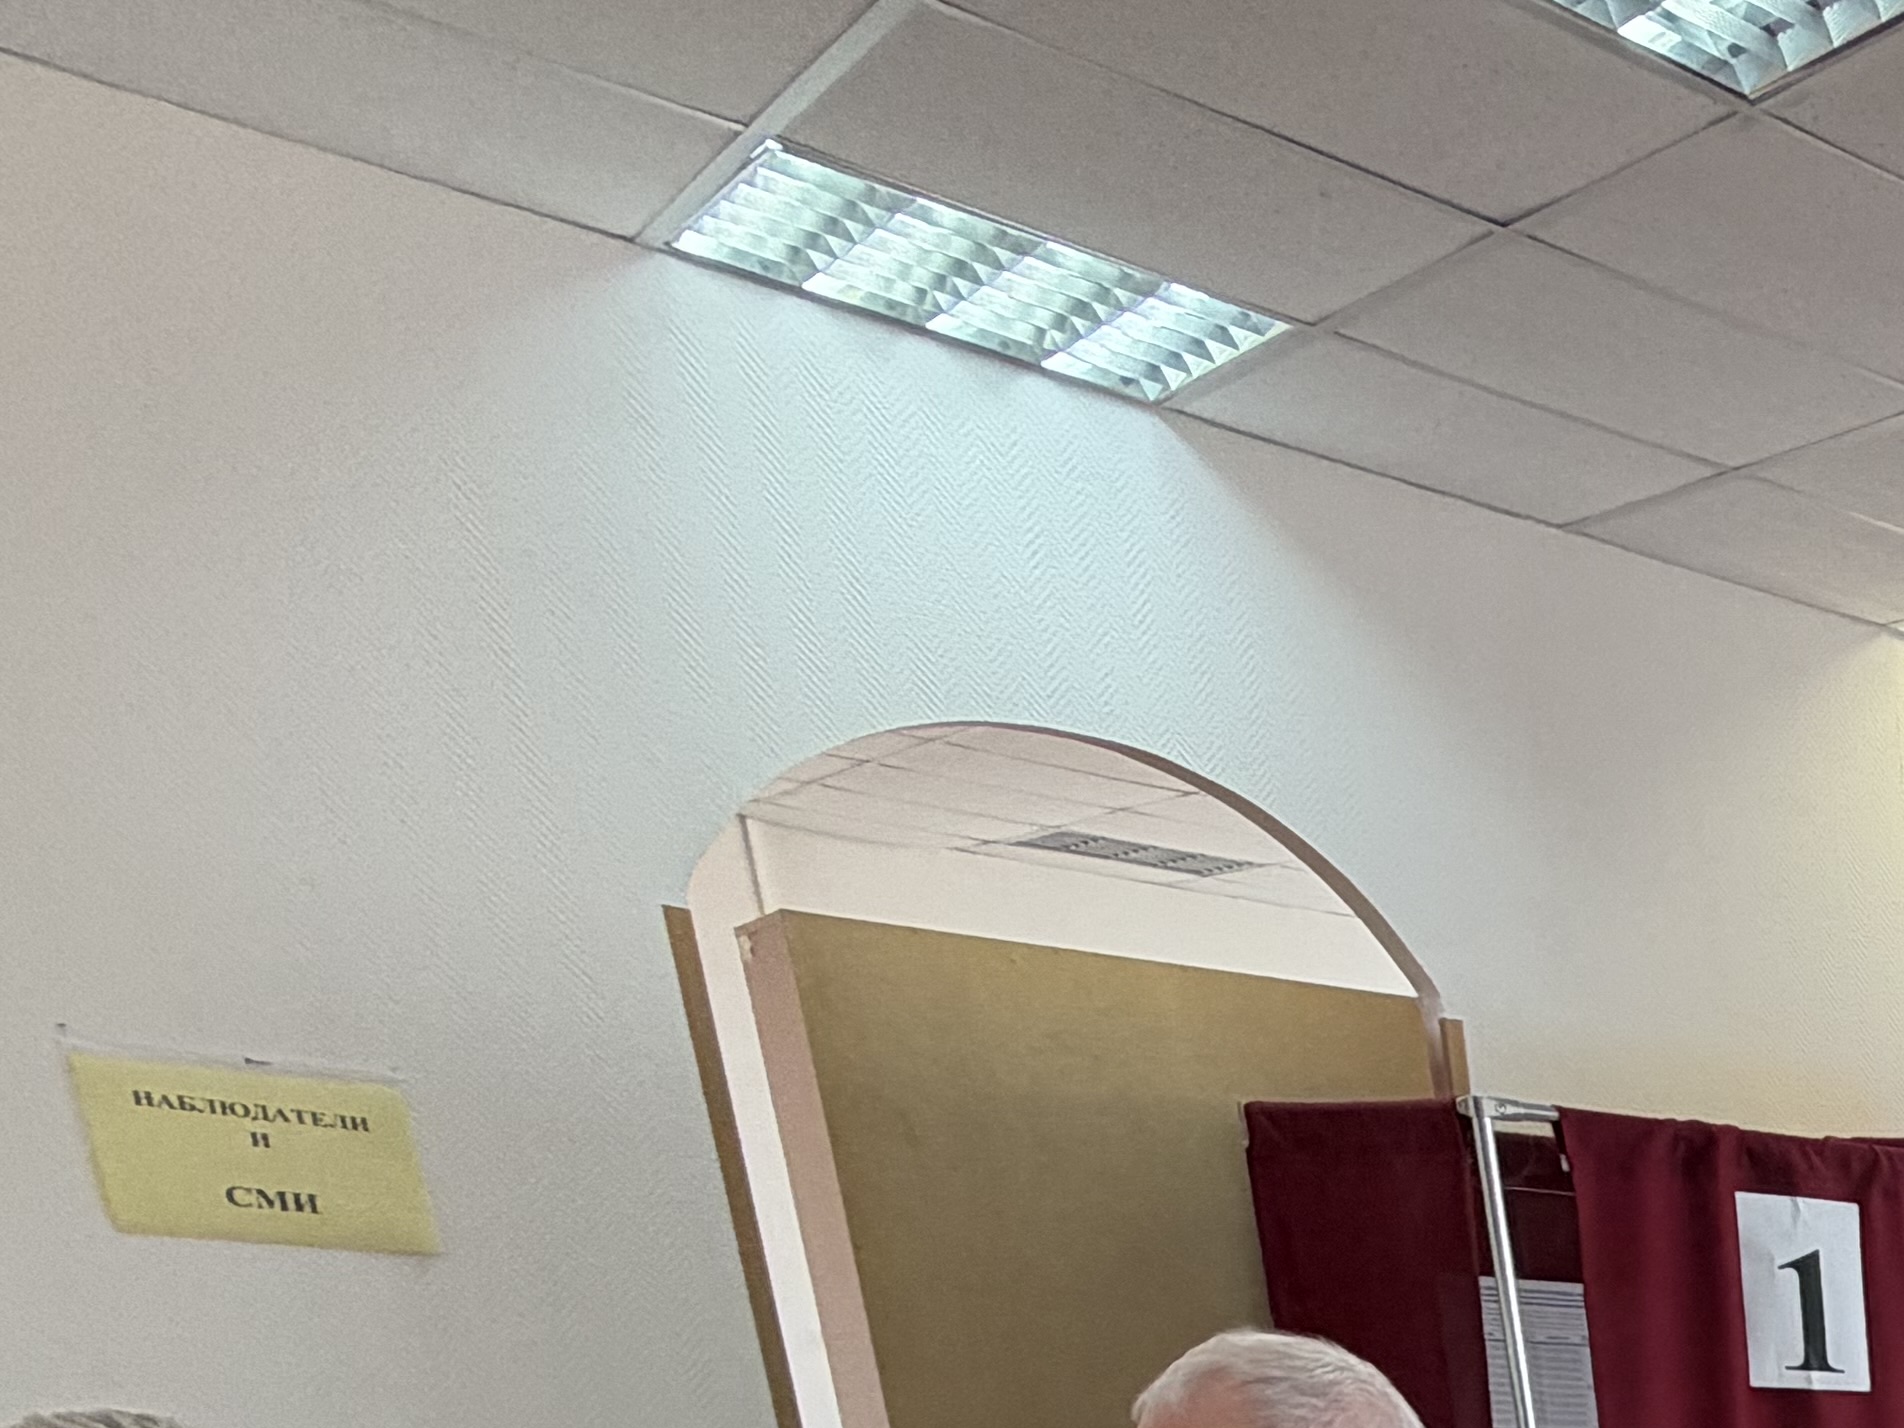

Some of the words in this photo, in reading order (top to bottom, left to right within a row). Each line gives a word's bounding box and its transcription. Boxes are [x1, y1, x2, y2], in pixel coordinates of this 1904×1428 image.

[132, 1088, 371, 1132] НАБЛЮДАТЕЛИ
[250, 1131, 271, 1149] И
[225, 1185, 321, 1215] СМИ
[1778, 1249, 1845, 1375] 1
